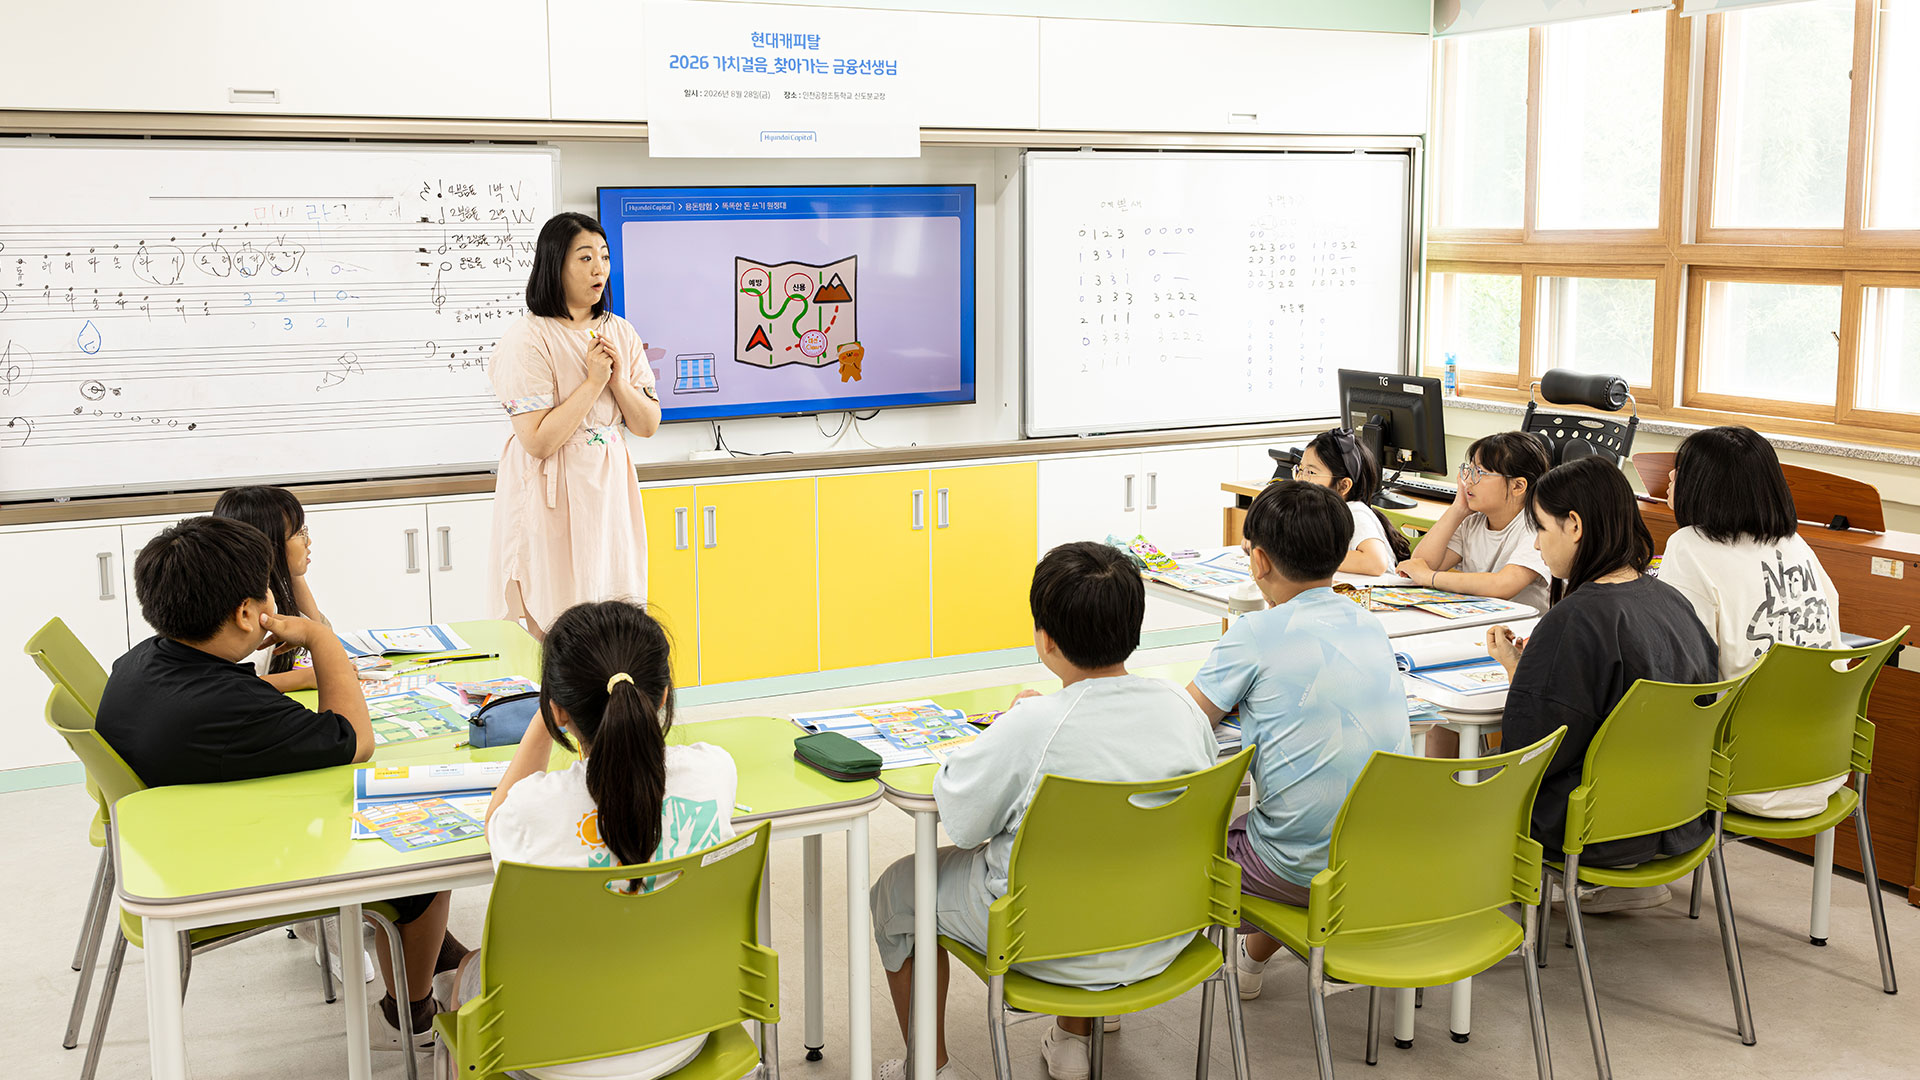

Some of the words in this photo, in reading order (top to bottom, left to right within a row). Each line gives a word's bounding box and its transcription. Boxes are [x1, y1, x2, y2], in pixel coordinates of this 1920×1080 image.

[751, 31, 821, 50] 현대캐피탈
[669, 54, 709, 70] 2026
[713, 56, 829, 75] 가치걸음_찾아가는
[832, 59, 897, 76] 금융선생님
[684, 89, 698, 98] 일시
[704, 89, 729, 98] 2026년
[730, 90, 742, 99] 8월
[743, 90, 771, 100] 28일(금)
[783, 91, 797, 99] 장소
[790, 134, 813, 142] Capital
[1378, 376, 1389, 386] TG
